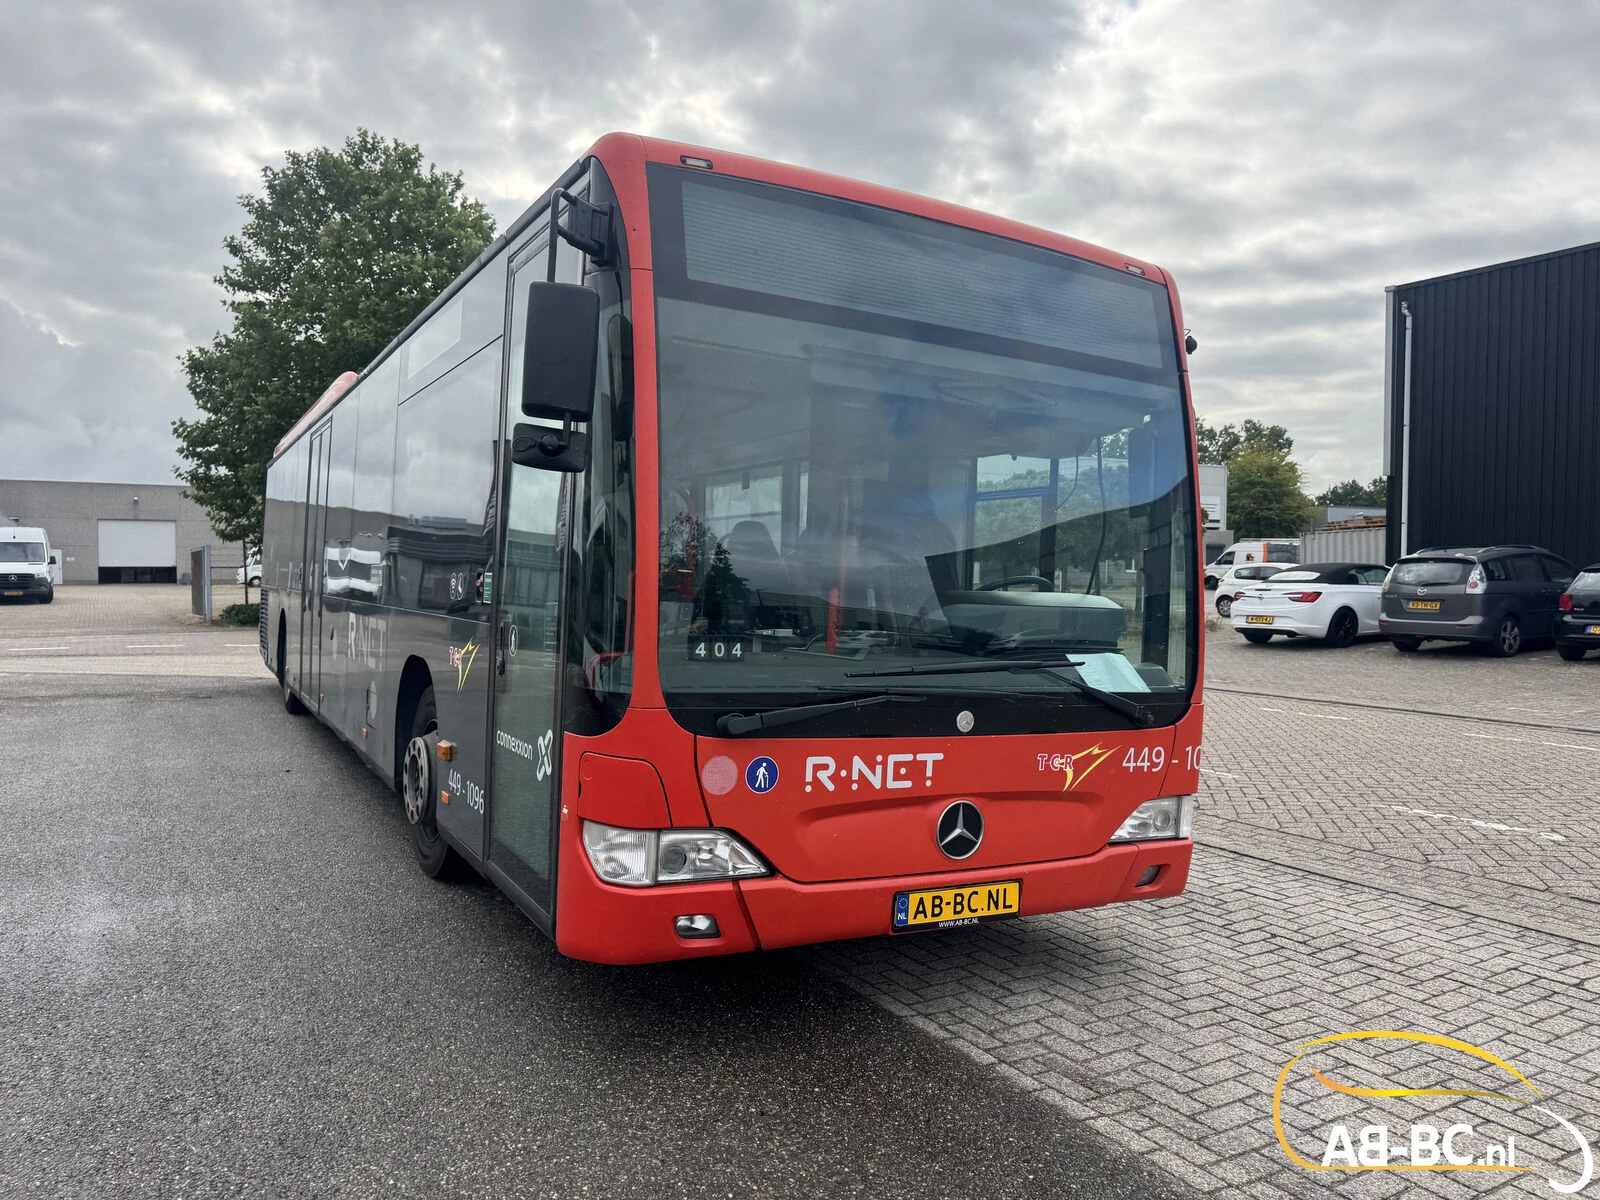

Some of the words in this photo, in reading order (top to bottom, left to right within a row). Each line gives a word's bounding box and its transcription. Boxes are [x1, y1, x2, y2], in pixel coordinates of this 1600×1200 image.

[496, 730, 533, 760] connexxion
[1037, 753, 1074, 772] TCR
[1122, 747, 1165, 772] 449
[448, 768, 461, 796] 449
[466, 780, 485, 815] 1096
[897, 912, 908, 921] NL
[912, 887, 1013, 920] AB-BC.NL
